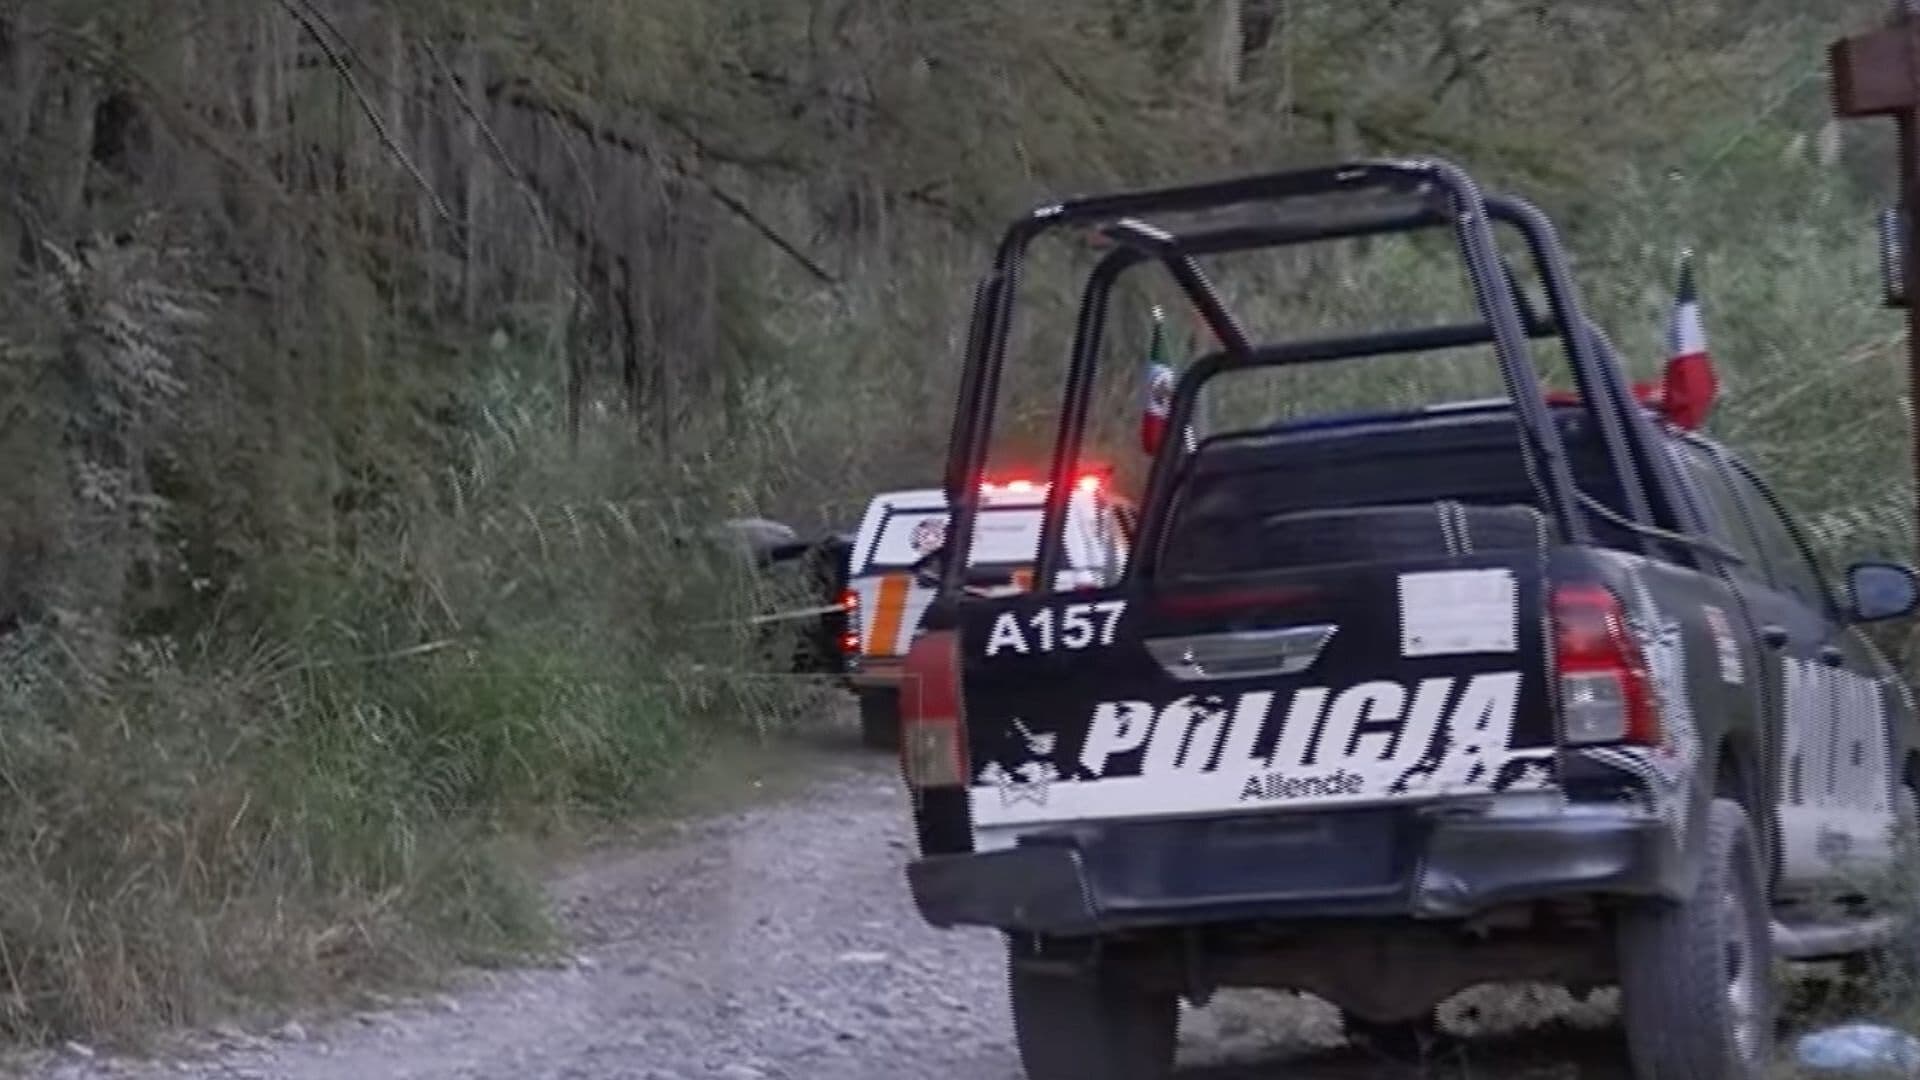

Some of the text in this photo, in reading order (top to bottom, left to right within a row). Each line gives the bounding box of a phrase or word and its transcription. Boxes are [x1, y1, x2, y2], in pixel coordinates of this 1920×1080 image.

[986, 600, 1128, 656] A157
[1079, 672, 1523, 790] POLICIA
[1241, 768, 1364, 801] Allende
